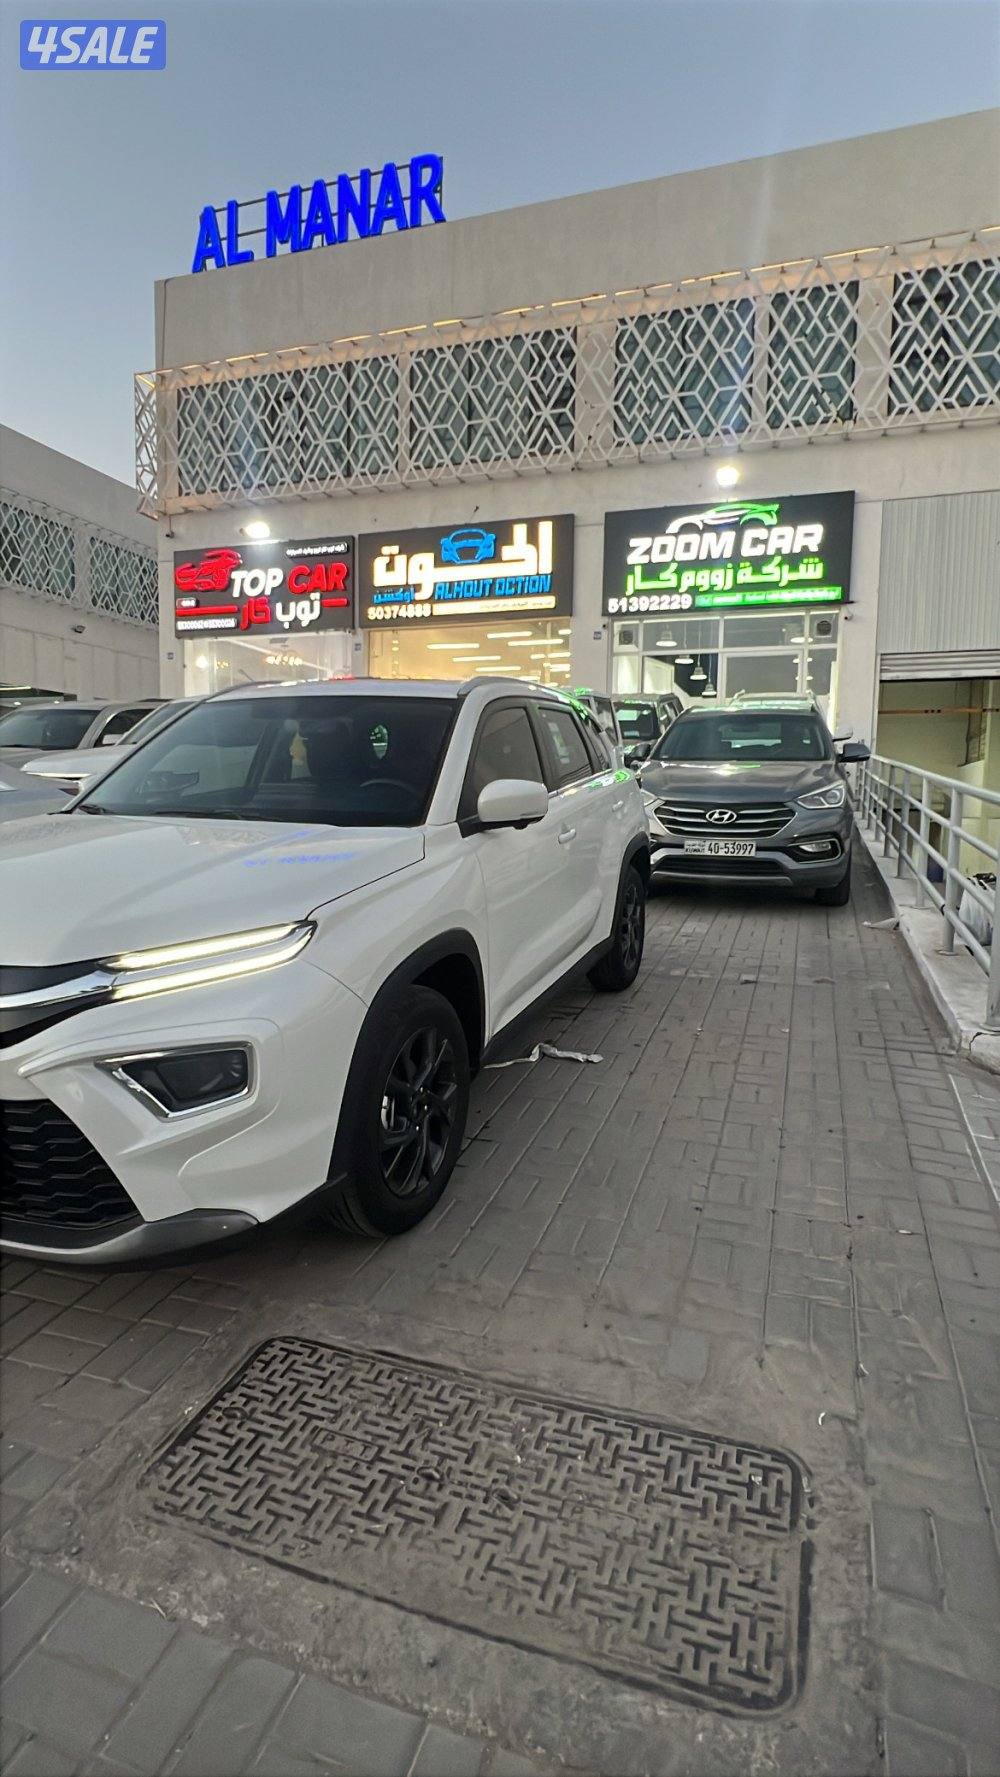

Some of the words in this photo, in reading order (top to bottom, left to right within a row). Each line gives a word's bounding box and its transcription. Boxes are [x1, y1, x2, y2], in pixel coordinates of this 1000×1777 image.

[192, 200, 254, 273] AL
[266, 153, 446, 258] MANAR
[373, 521, 553, 600] الحوت
[626, 532, 736, 565] ZOOM
[740, 523, 824, 556] CAR
[230, 568, 284, 598] TOP
[287, 562, 348, 595] CAR
[434, 580, 493, 600] ALHOUT
[495, 574, 552, 597] OCTION
[625, 562, 679, 597] كار
[736, 556, 825, 588] شركة
[239, 597, 272, 630] كار
[275, 592, 321, 629] توب
[707, 842, 754, 855] 40-53997
